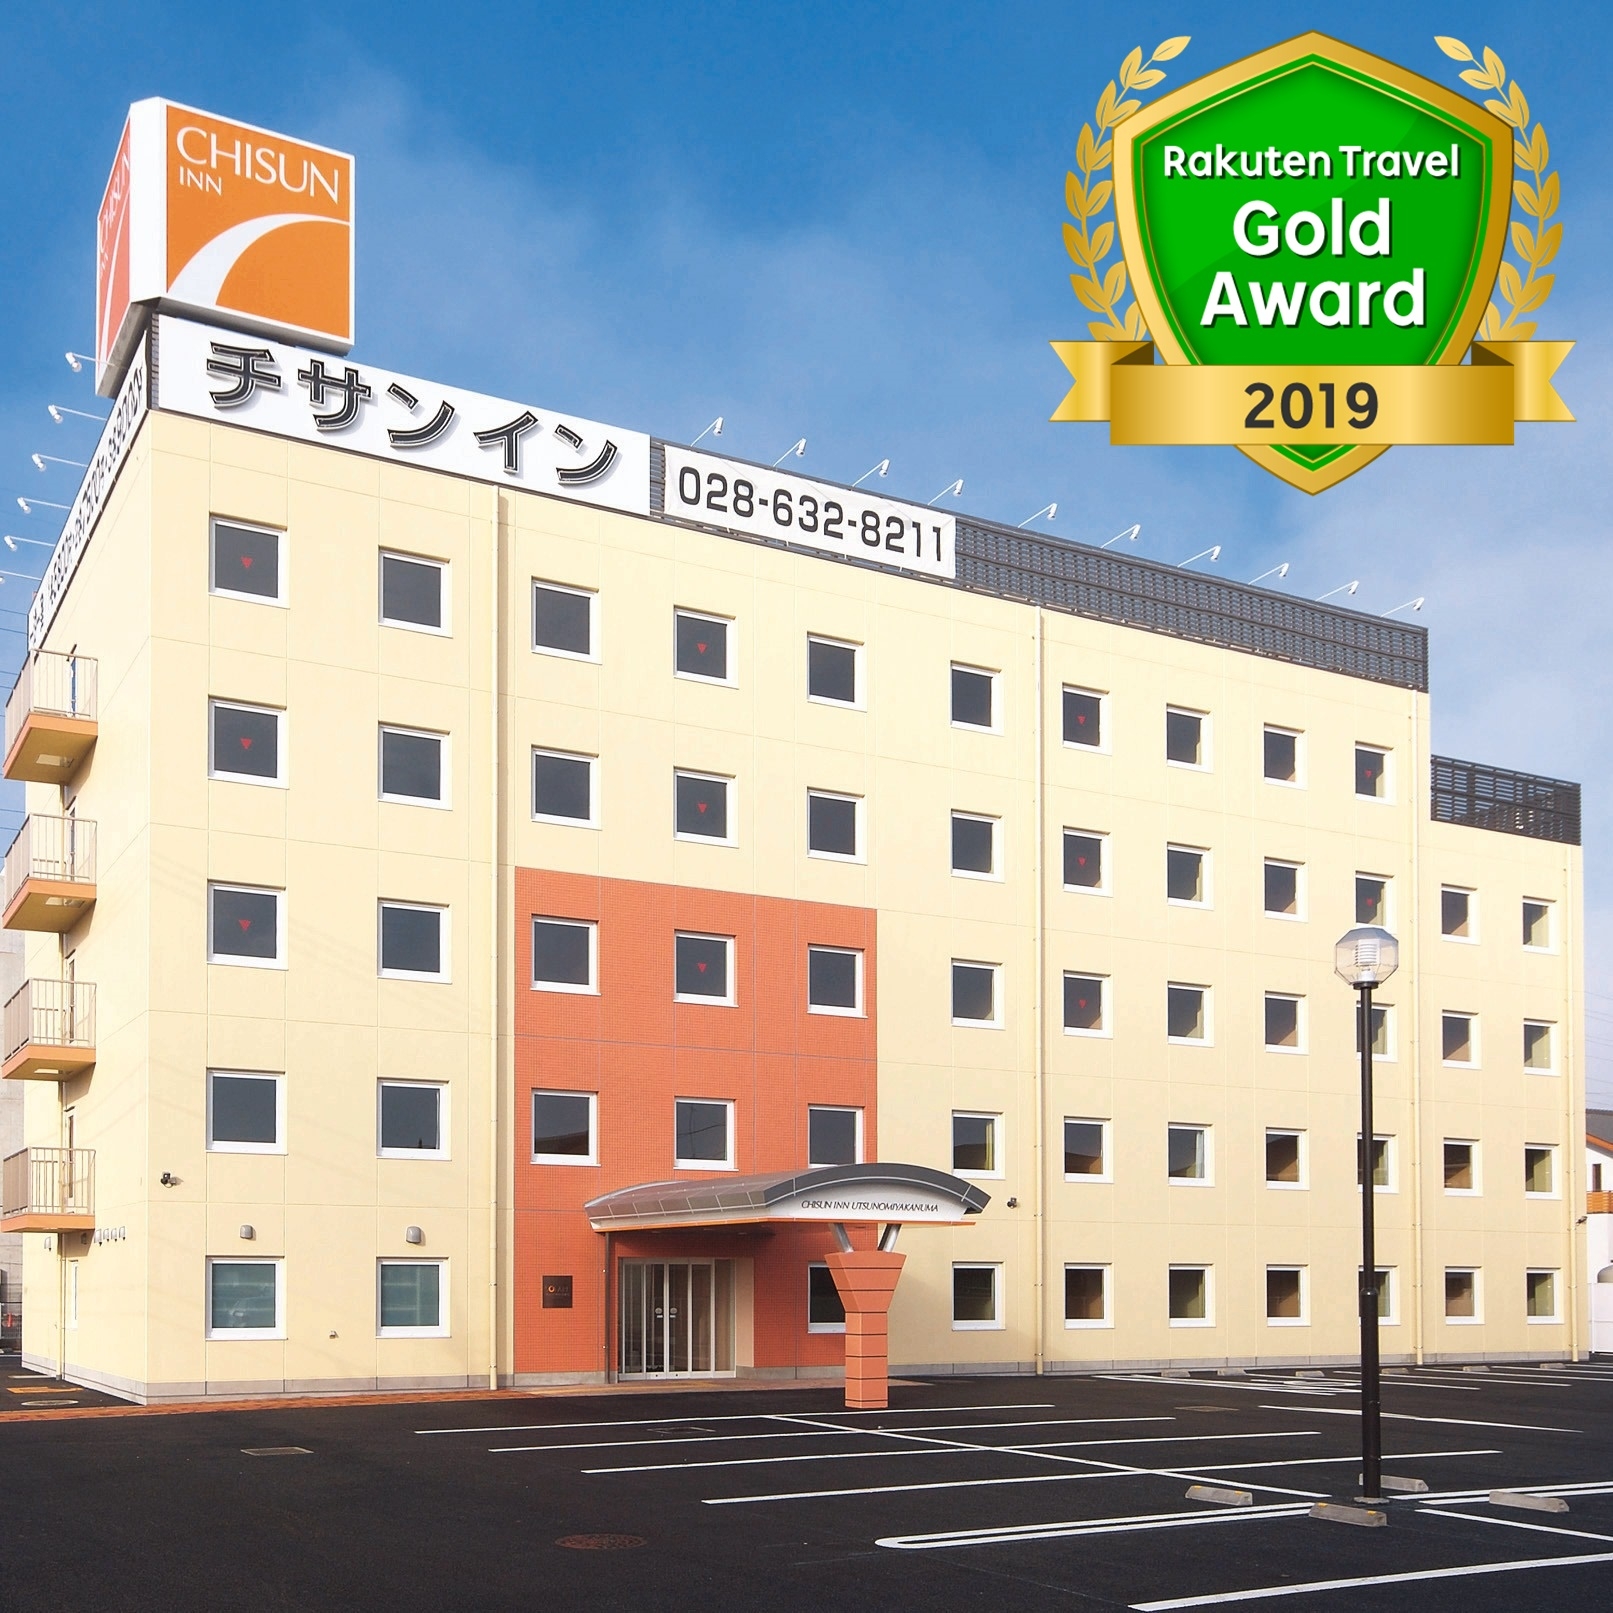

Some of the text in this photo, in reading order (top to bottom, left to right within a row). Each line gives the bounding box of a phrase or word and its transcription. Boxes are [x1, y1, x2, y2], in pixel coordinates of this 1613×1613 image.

[176, 126, 339, 205] CHISUN
[179, 165, 222, 196] INN
[206, 341, 618, 484] チサンイン
[678, 466, 942, 562] 028-632-8211
[801, 1199, 939, 1212] CHISUN INN UTSUNOMIYAKANUMA
